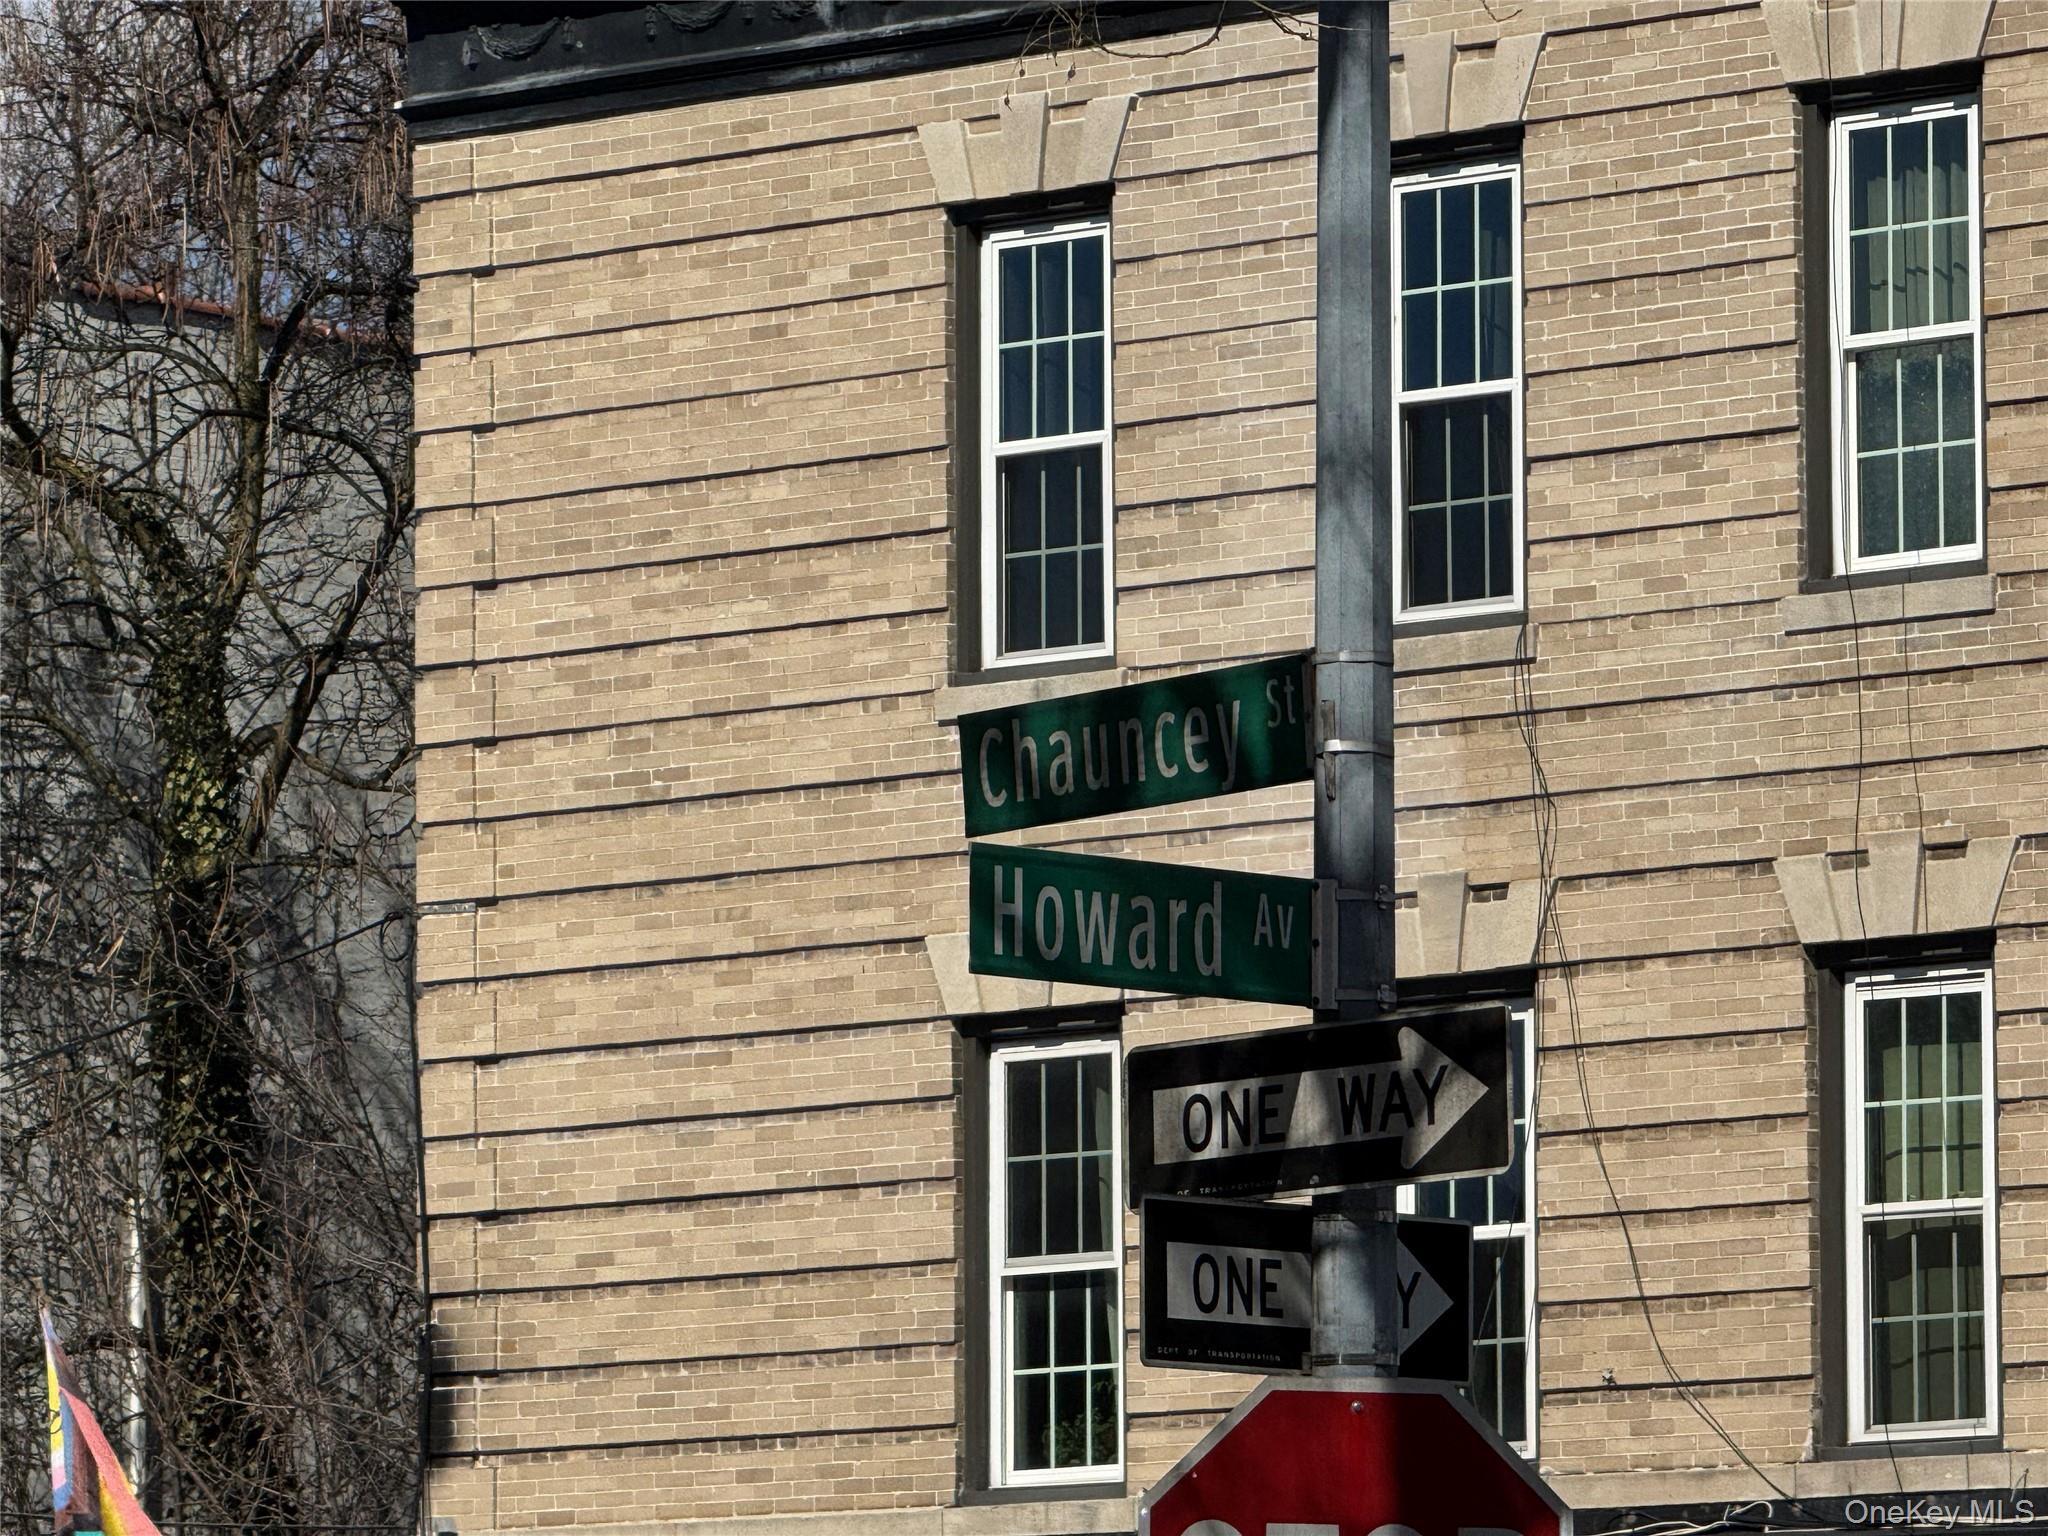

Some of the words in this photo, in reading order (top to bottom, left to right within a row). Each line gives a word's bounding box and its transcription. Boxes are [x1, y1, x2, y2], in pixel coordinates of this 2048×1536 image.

[979, 699, 1241, 808] Chauncey
[1266, 675, 1297, 728] St
[994, 865, 1222, 977] Howard
[1253, 893, 1294, 949] Av
[1183, 1084, 1287, 1153] ONE
[1337, 1065, 1449, 1136] WAY
[1192, 1253, 1285, 1319] ONE
